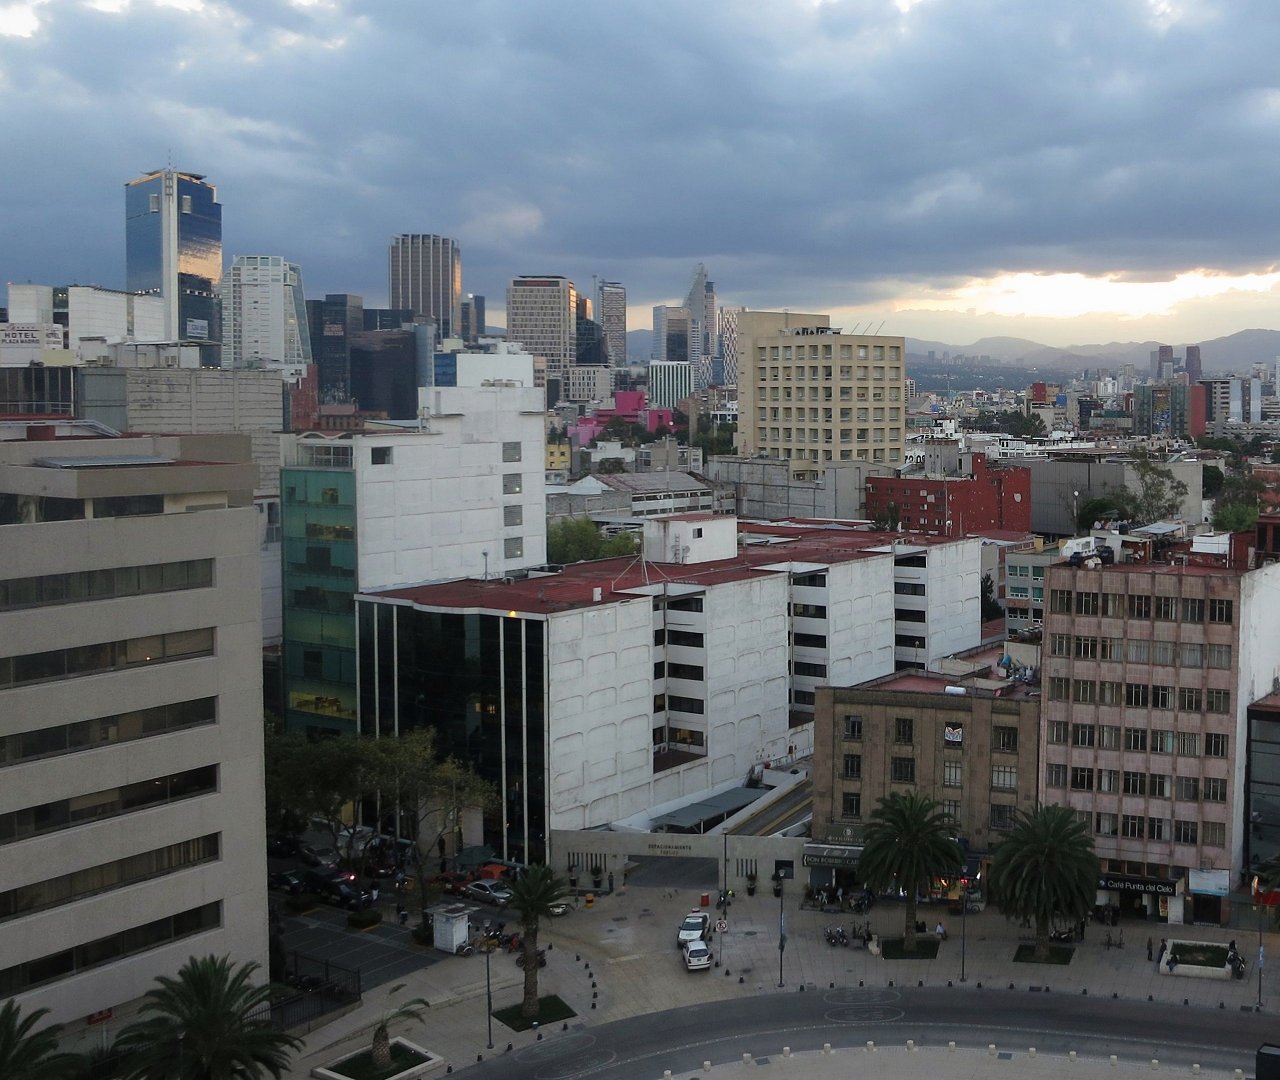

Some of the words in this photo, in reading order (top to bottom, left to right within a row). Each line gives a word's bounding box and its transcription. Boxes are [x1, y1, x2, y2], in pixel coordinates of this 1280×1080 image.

[1107, 880, 1124, 888] Café
[1125, 881, 1144, 891] Punta
[1156, 884, 1173, 893] Cielo
